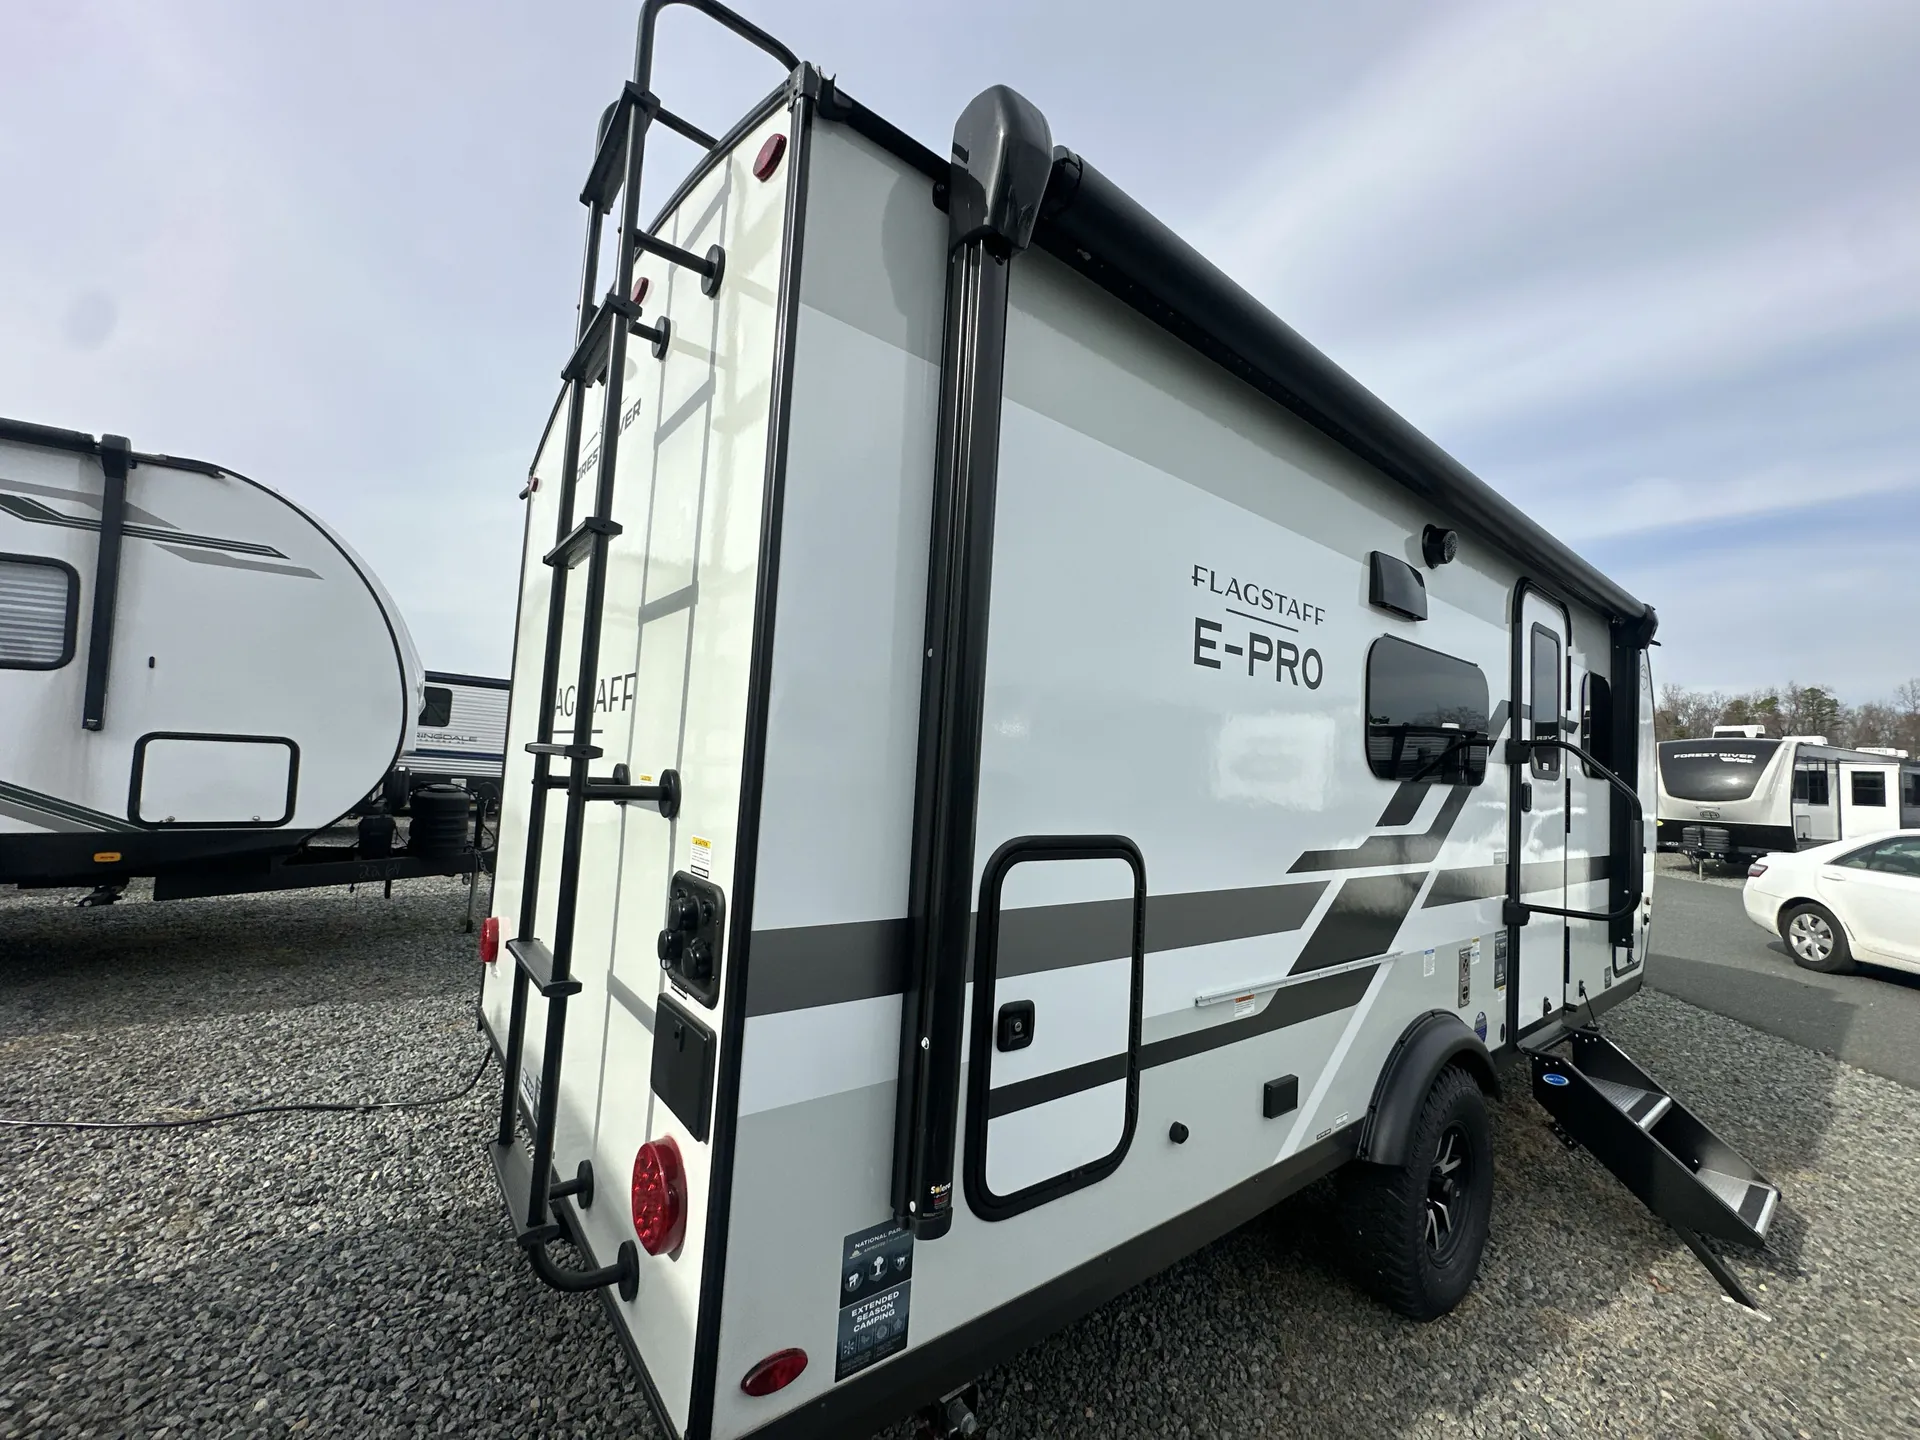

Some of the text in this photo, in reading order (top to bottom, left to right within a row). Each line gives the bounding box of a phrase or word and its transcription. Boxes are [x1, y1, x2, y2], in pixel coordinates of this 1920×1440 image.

[1191, 564, 1326, 626] FLAGSTAFF
[1193, 616, 1324, 691] E-PRO
[554, 672, 638, 718] AGAFF
[1718, 752, 1757, 760] RIVER
[854, 1232, 888, 1249] NATIONAL
[887, 1226, 903, 1237] PAR
[851, 1290, 900, 1318] EXTENDED
[856, 1301, 894, 1324] SEASON
[853, 1309, 896, 1333] CAMPING
